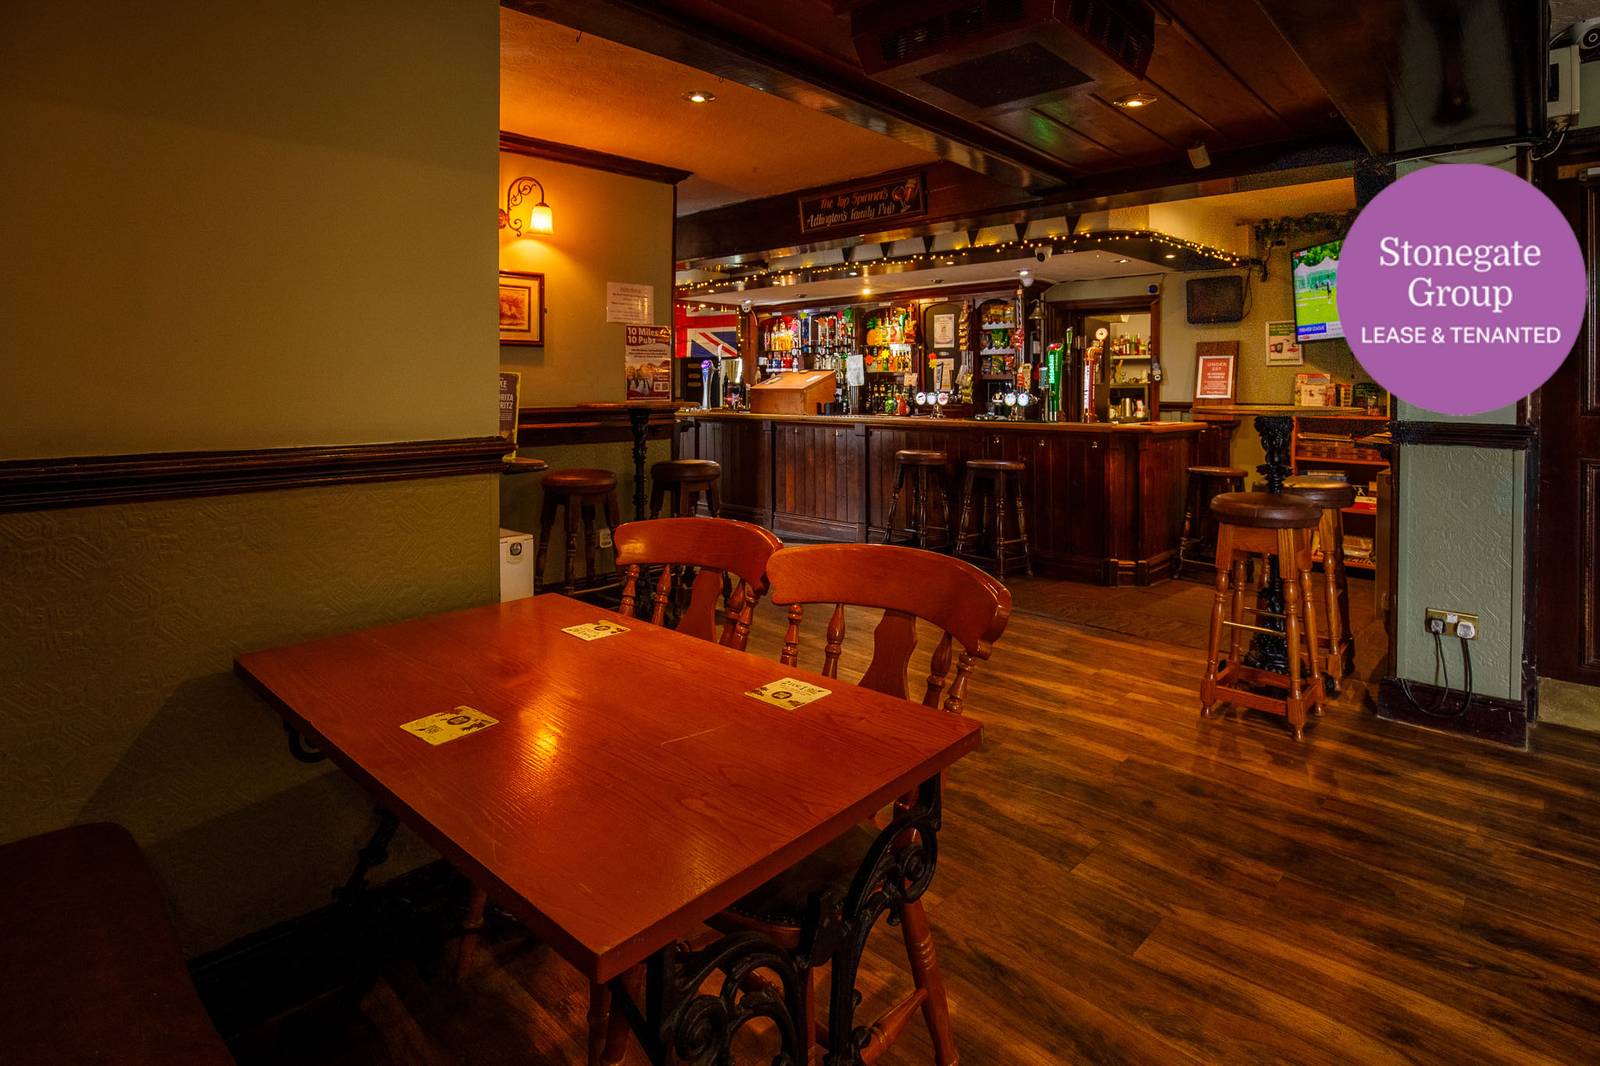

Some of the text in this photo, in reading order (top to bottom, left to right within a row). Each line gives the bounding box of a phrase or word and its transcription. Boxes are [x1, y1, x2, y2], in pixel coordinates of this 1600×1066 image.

[878, 201, 896, 216] Pub
[627, 327, 659, 337] 10 Miles
[627, 335, 656, 344] 10 Pubs
